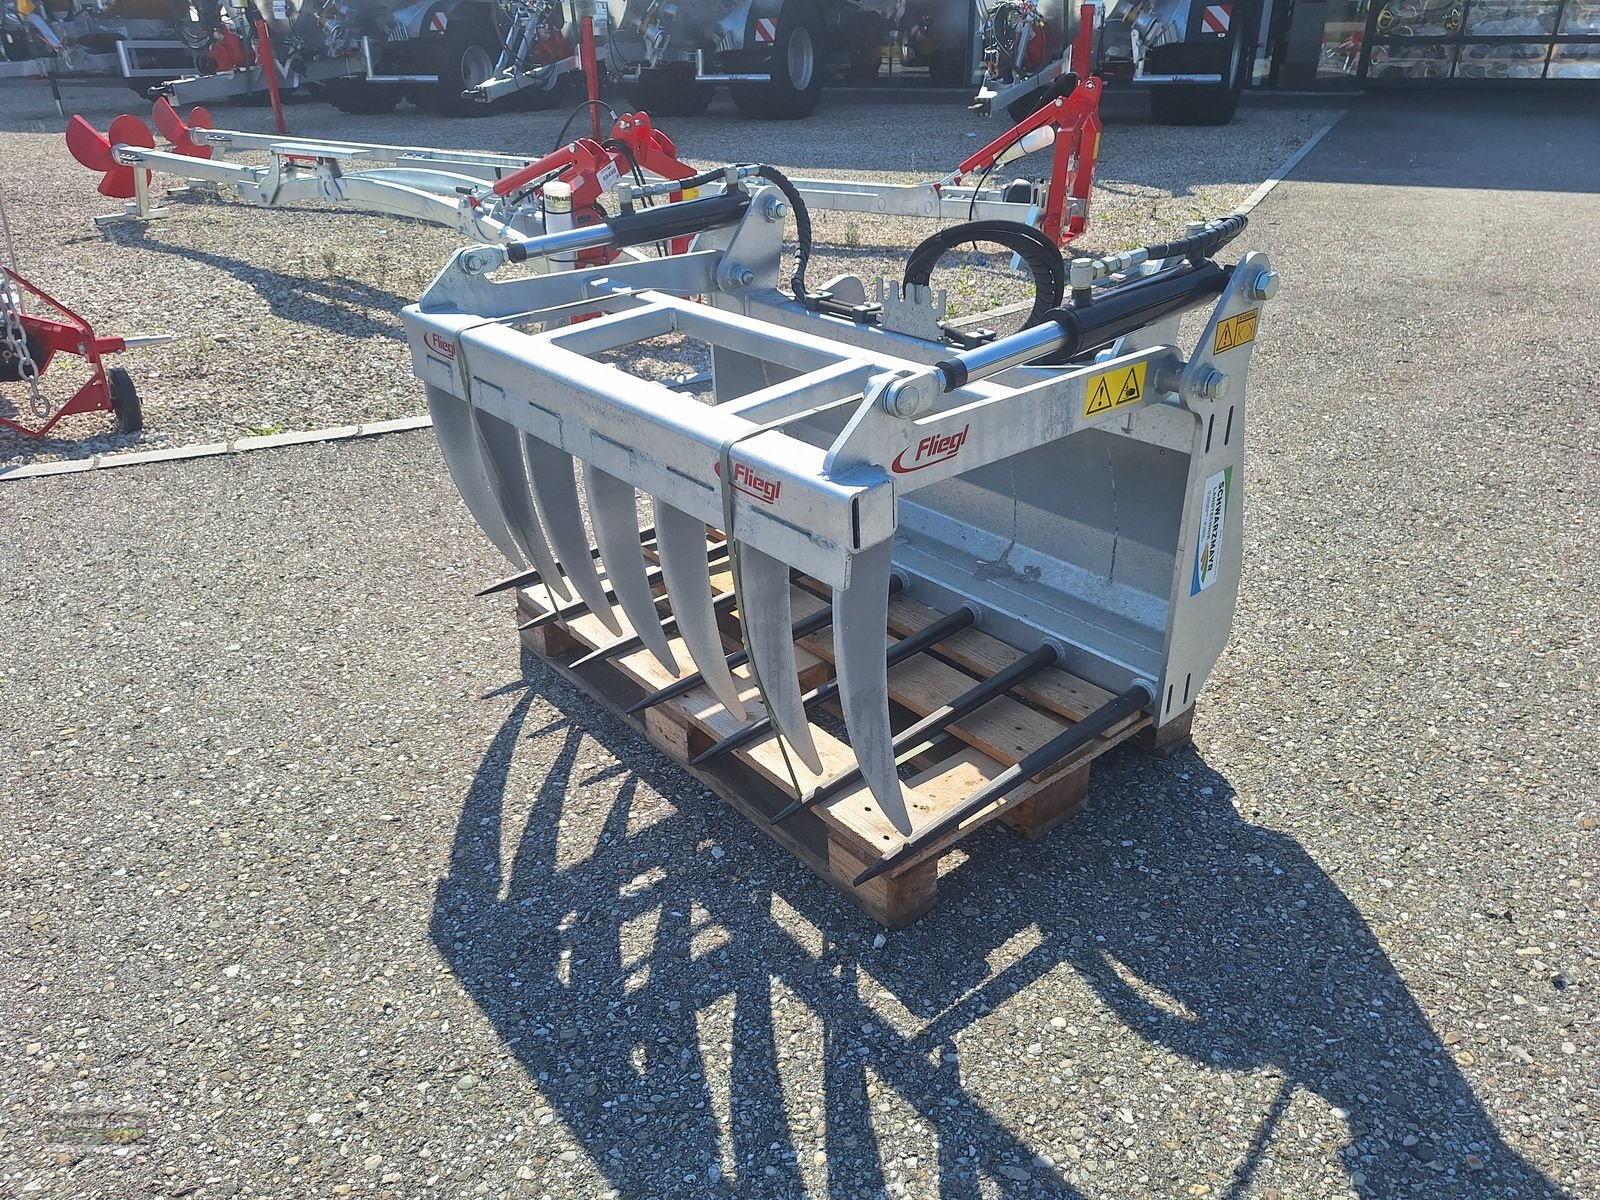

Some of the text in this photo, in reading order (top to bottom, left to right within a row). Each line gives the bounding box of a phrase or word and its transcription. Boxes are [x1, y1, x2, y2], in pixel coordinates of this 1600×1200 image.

[432, 332, 456, 357] Fliegl
[915, 423, 969, 461] Fliegl
[734, 463, 781, 501] Fliegl
[1207, 480, 1225, 571] SCHWARZMAYR
